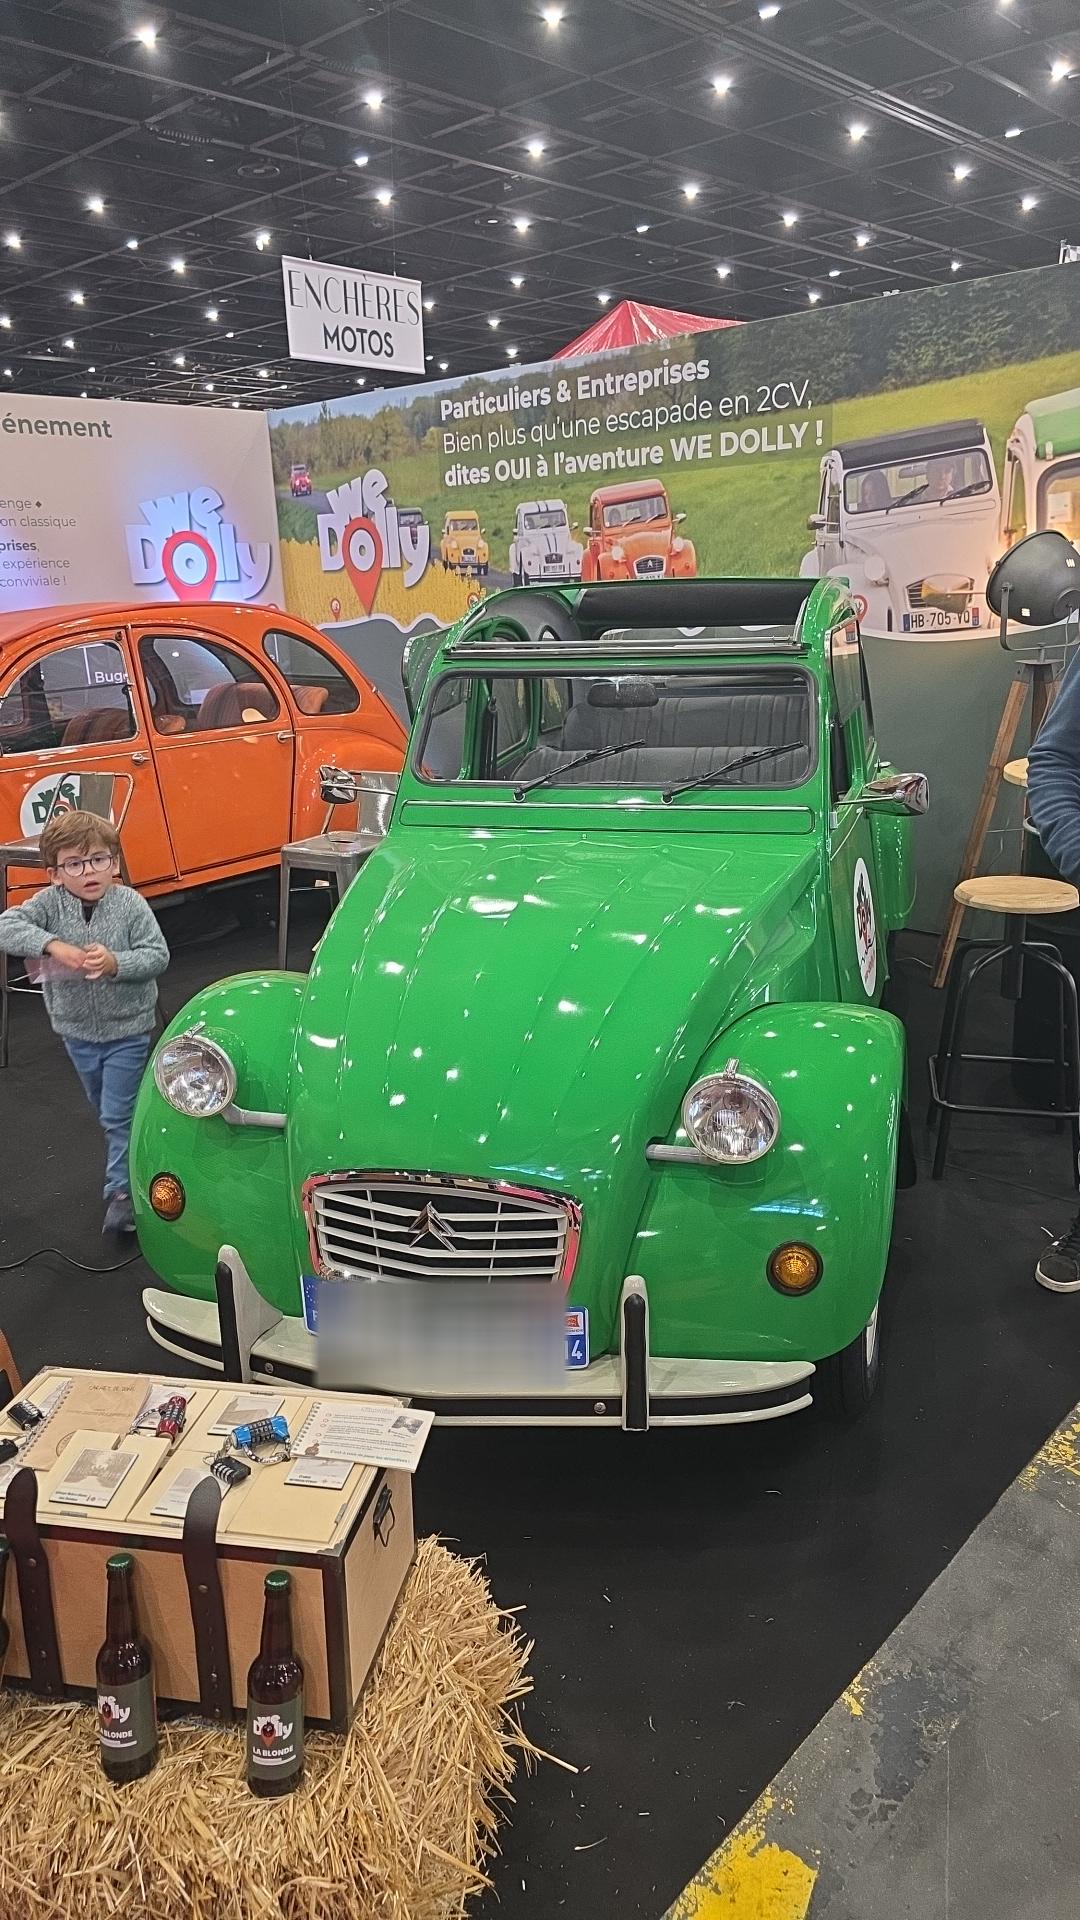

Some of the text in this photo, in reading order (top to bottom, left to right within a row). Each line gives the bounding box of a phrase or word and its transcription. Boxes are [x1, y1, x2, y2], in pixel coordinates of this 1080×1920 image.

[288, 270, 420, 326] ENCHÈRES
[323, 322, 394, 358] MOTOS
[440, 358, 710, 421] Particuliers & Entreprises
[0, 412, 112, 438] énement
[443, 379, 813, 454] Bien plus qu'une escapade en 2CV,
[444, 419, 823, 486] dites OUI à l'aventure WE DOLLY !
[20, 515, 76, 529] classique
[3, 557, 71, 571] expérience
[252, 1744, 294, 1757] LA BLONDE
